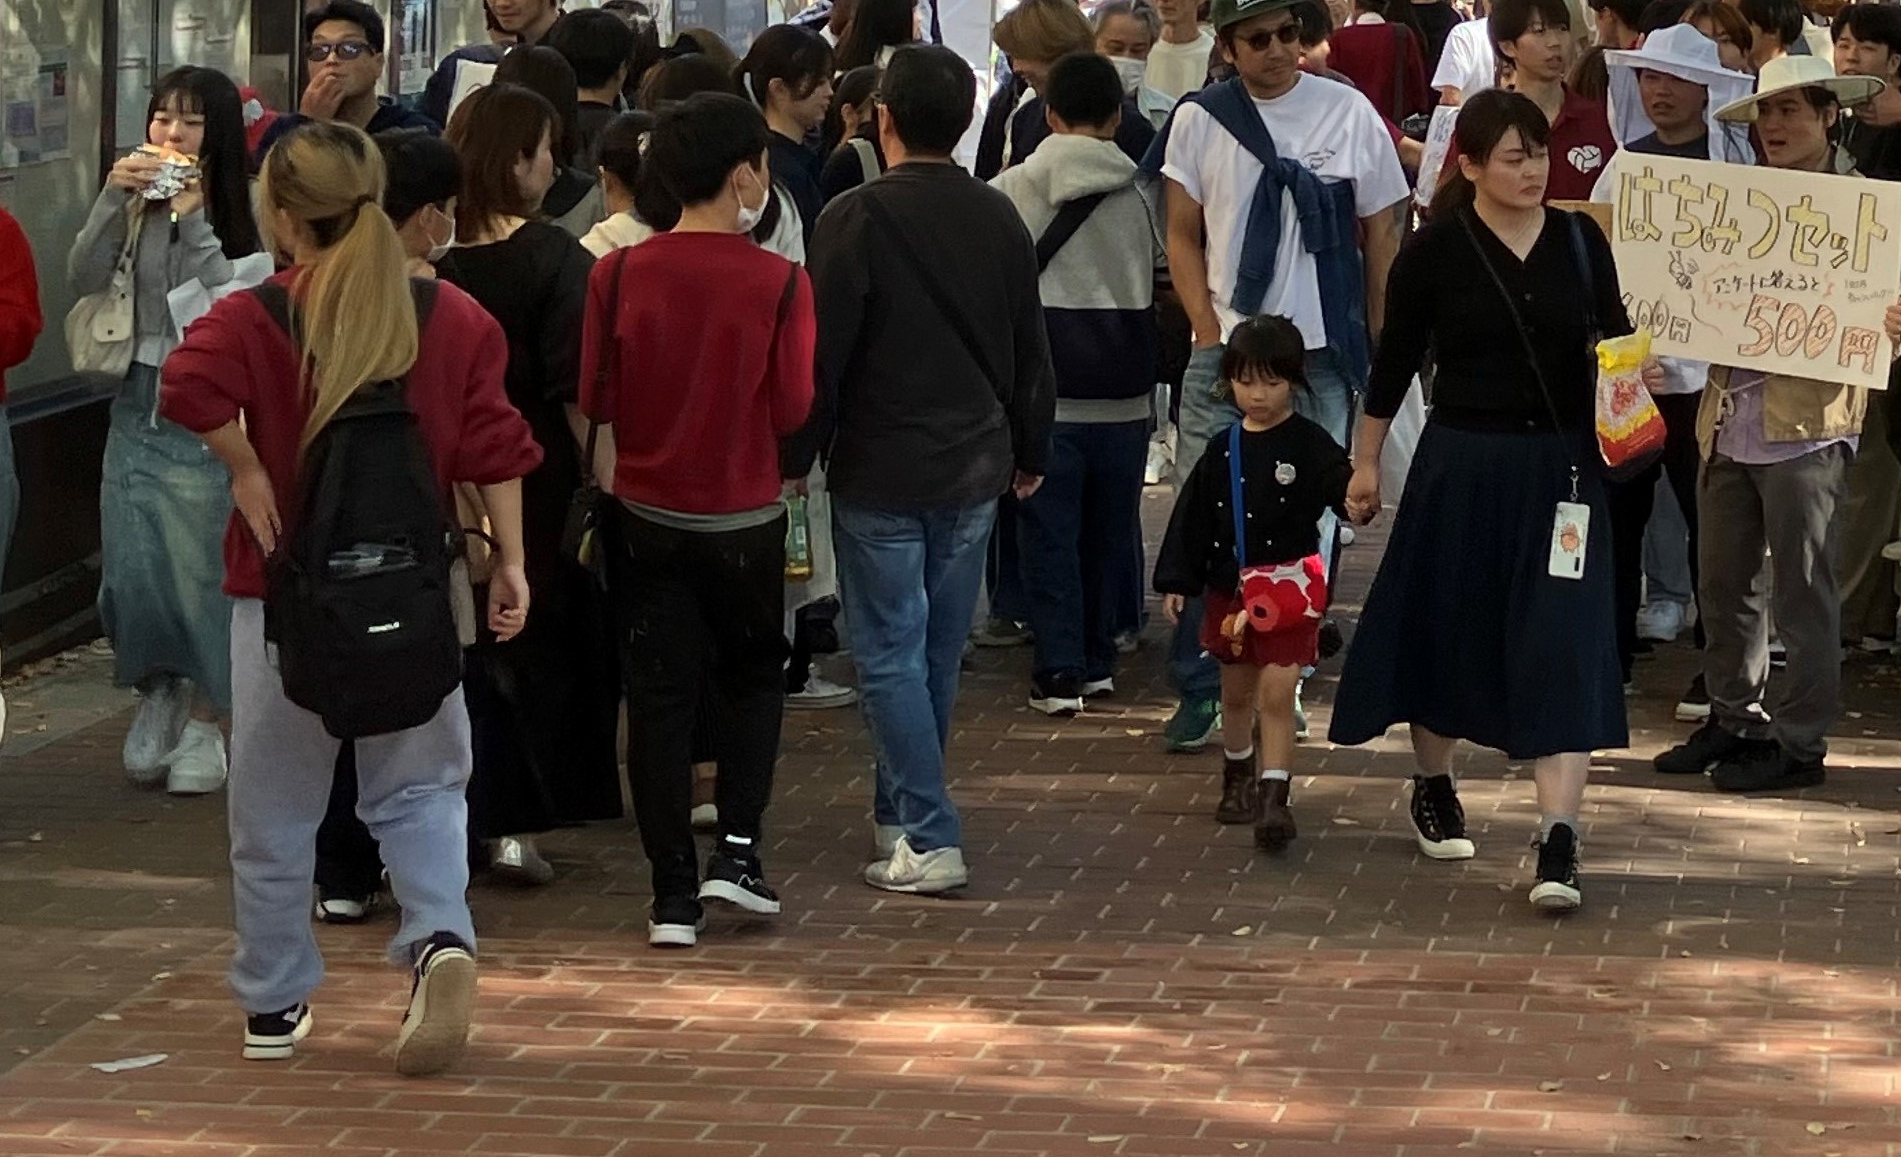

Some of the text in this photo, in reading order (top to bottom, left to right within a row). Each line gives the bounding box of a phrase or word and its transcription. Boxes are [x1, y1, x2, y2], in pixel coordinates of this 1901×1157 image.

[1619, 165, 1888, 273] はちみつセット
[1737, 294, 1881, 375] 500円
